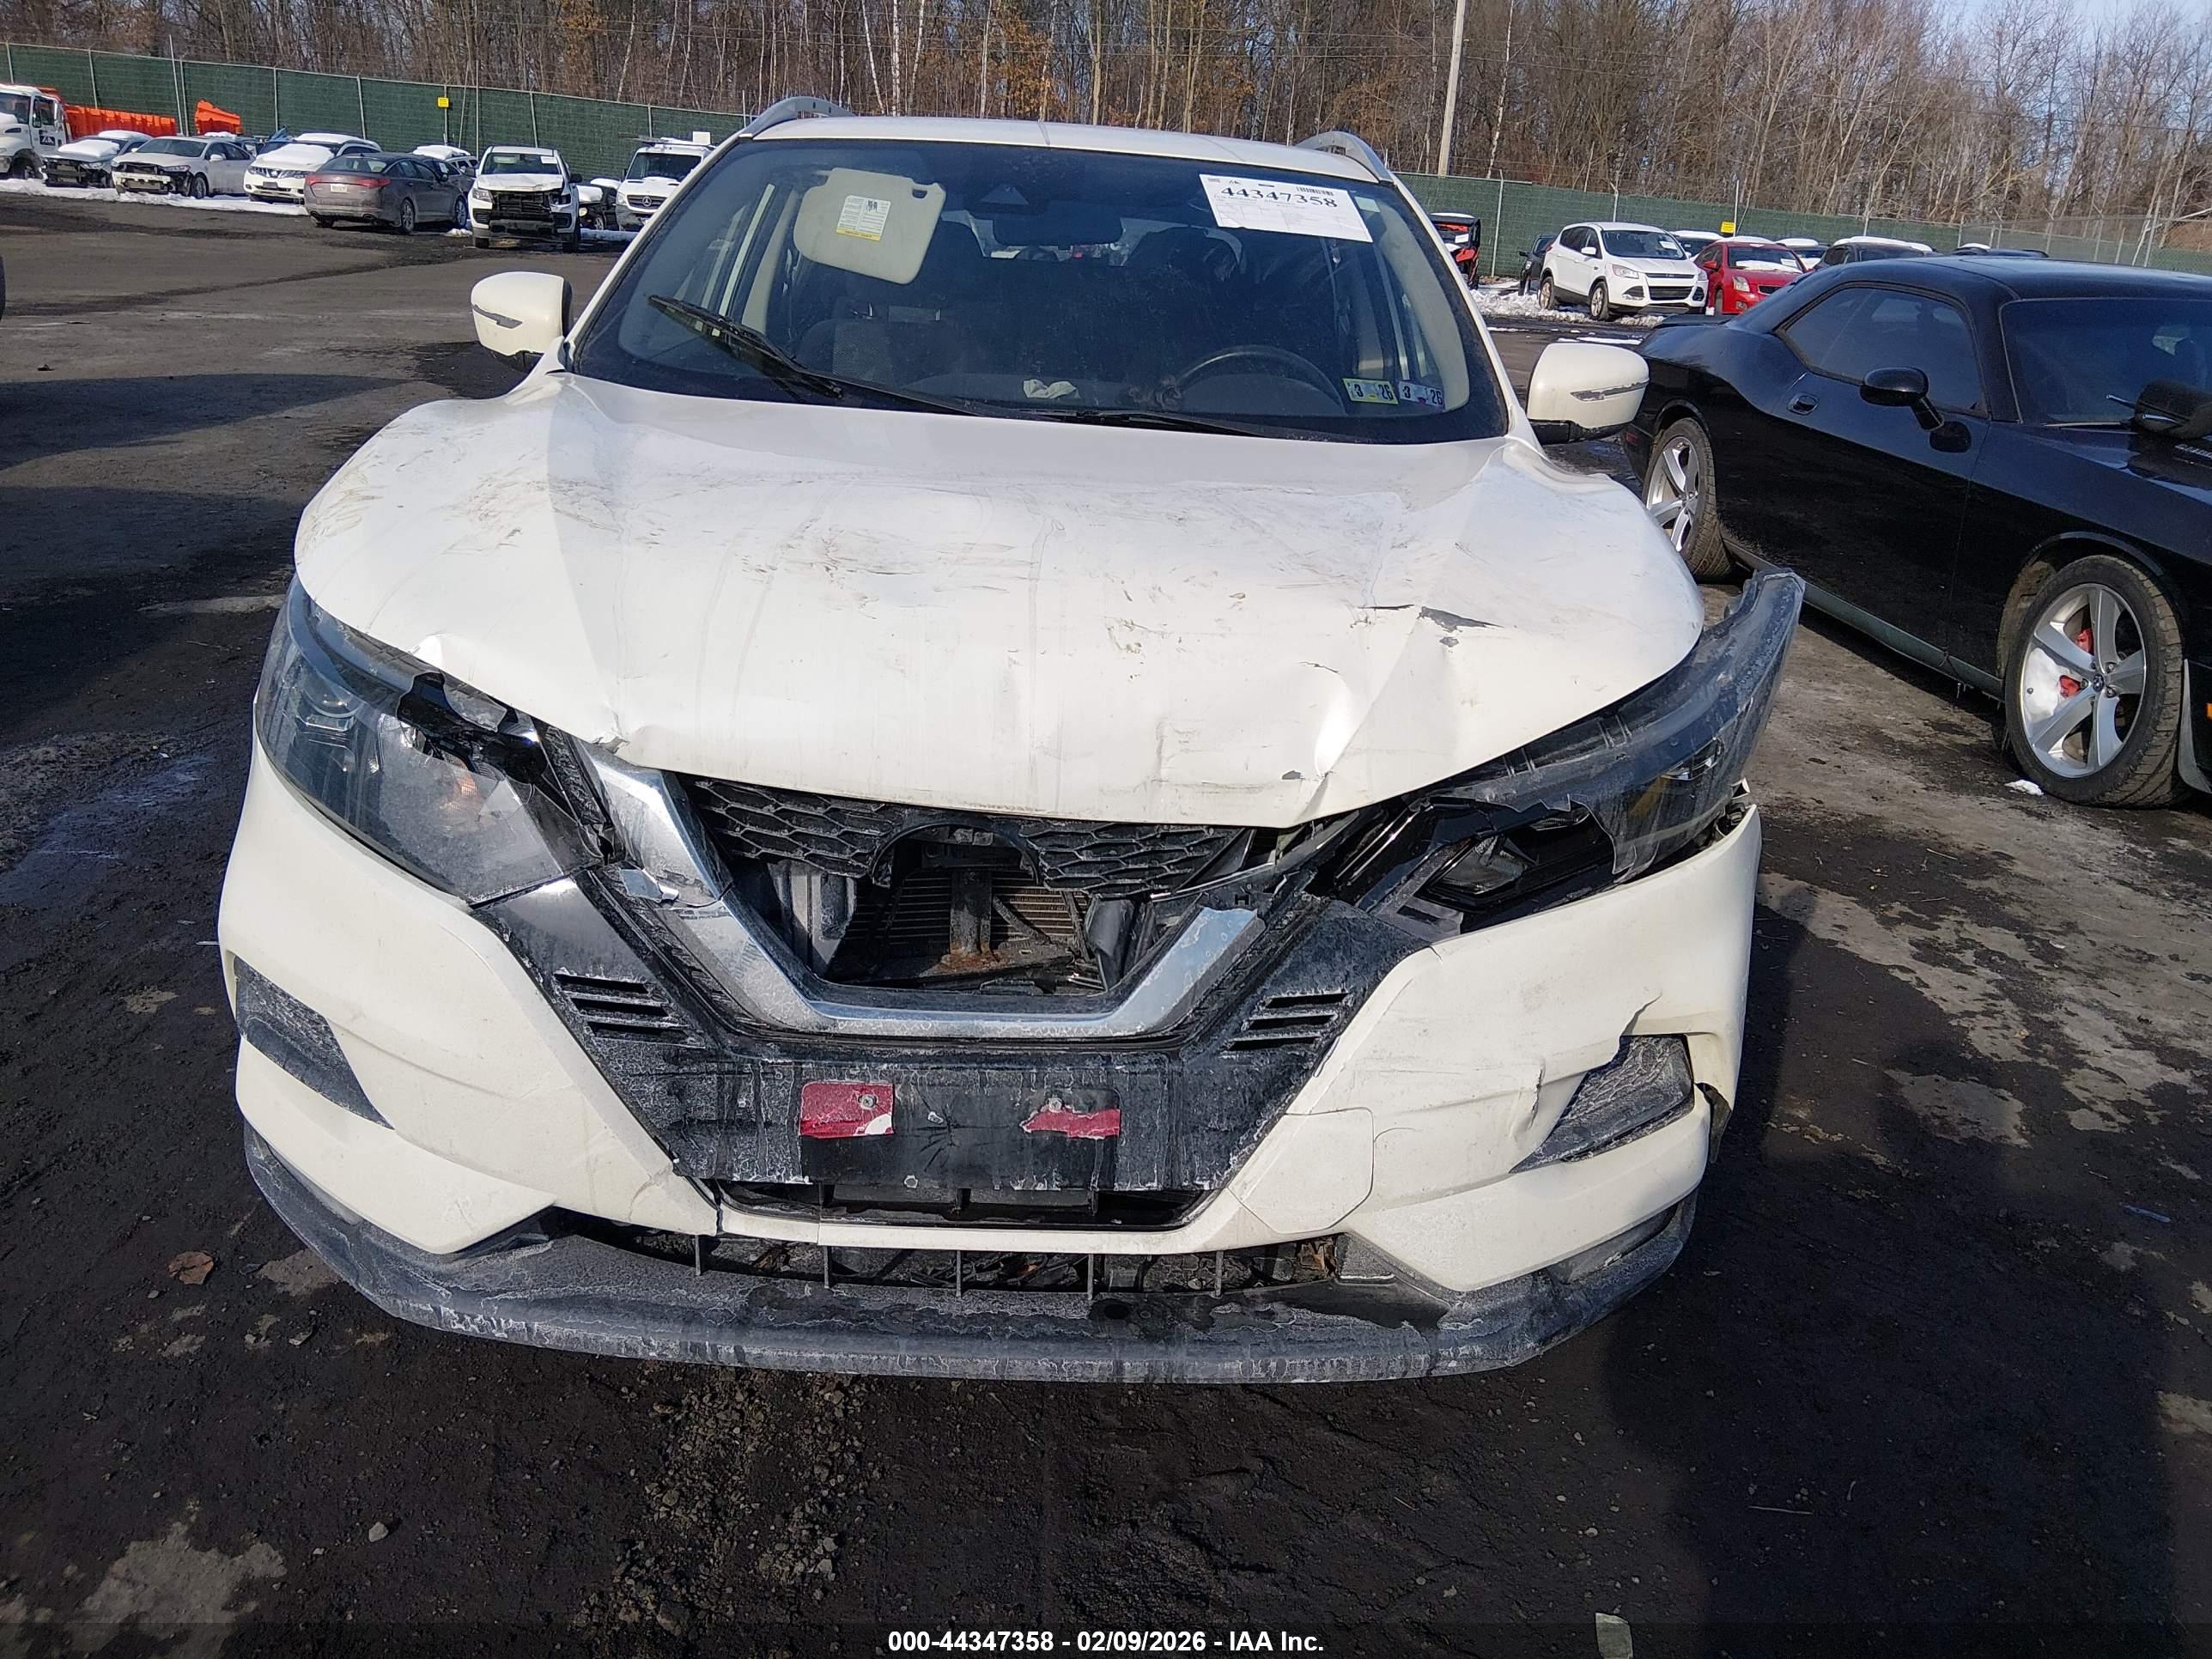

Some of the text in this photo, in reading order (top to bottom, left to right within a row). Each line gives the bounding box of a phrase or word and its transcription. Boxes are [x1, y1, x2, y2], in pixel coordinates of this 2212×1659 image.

[1221, 186, 1338, 208] 44347358
[1378, 385, 1394, 400] 26
[1430, 389, 1443, 405] 26
